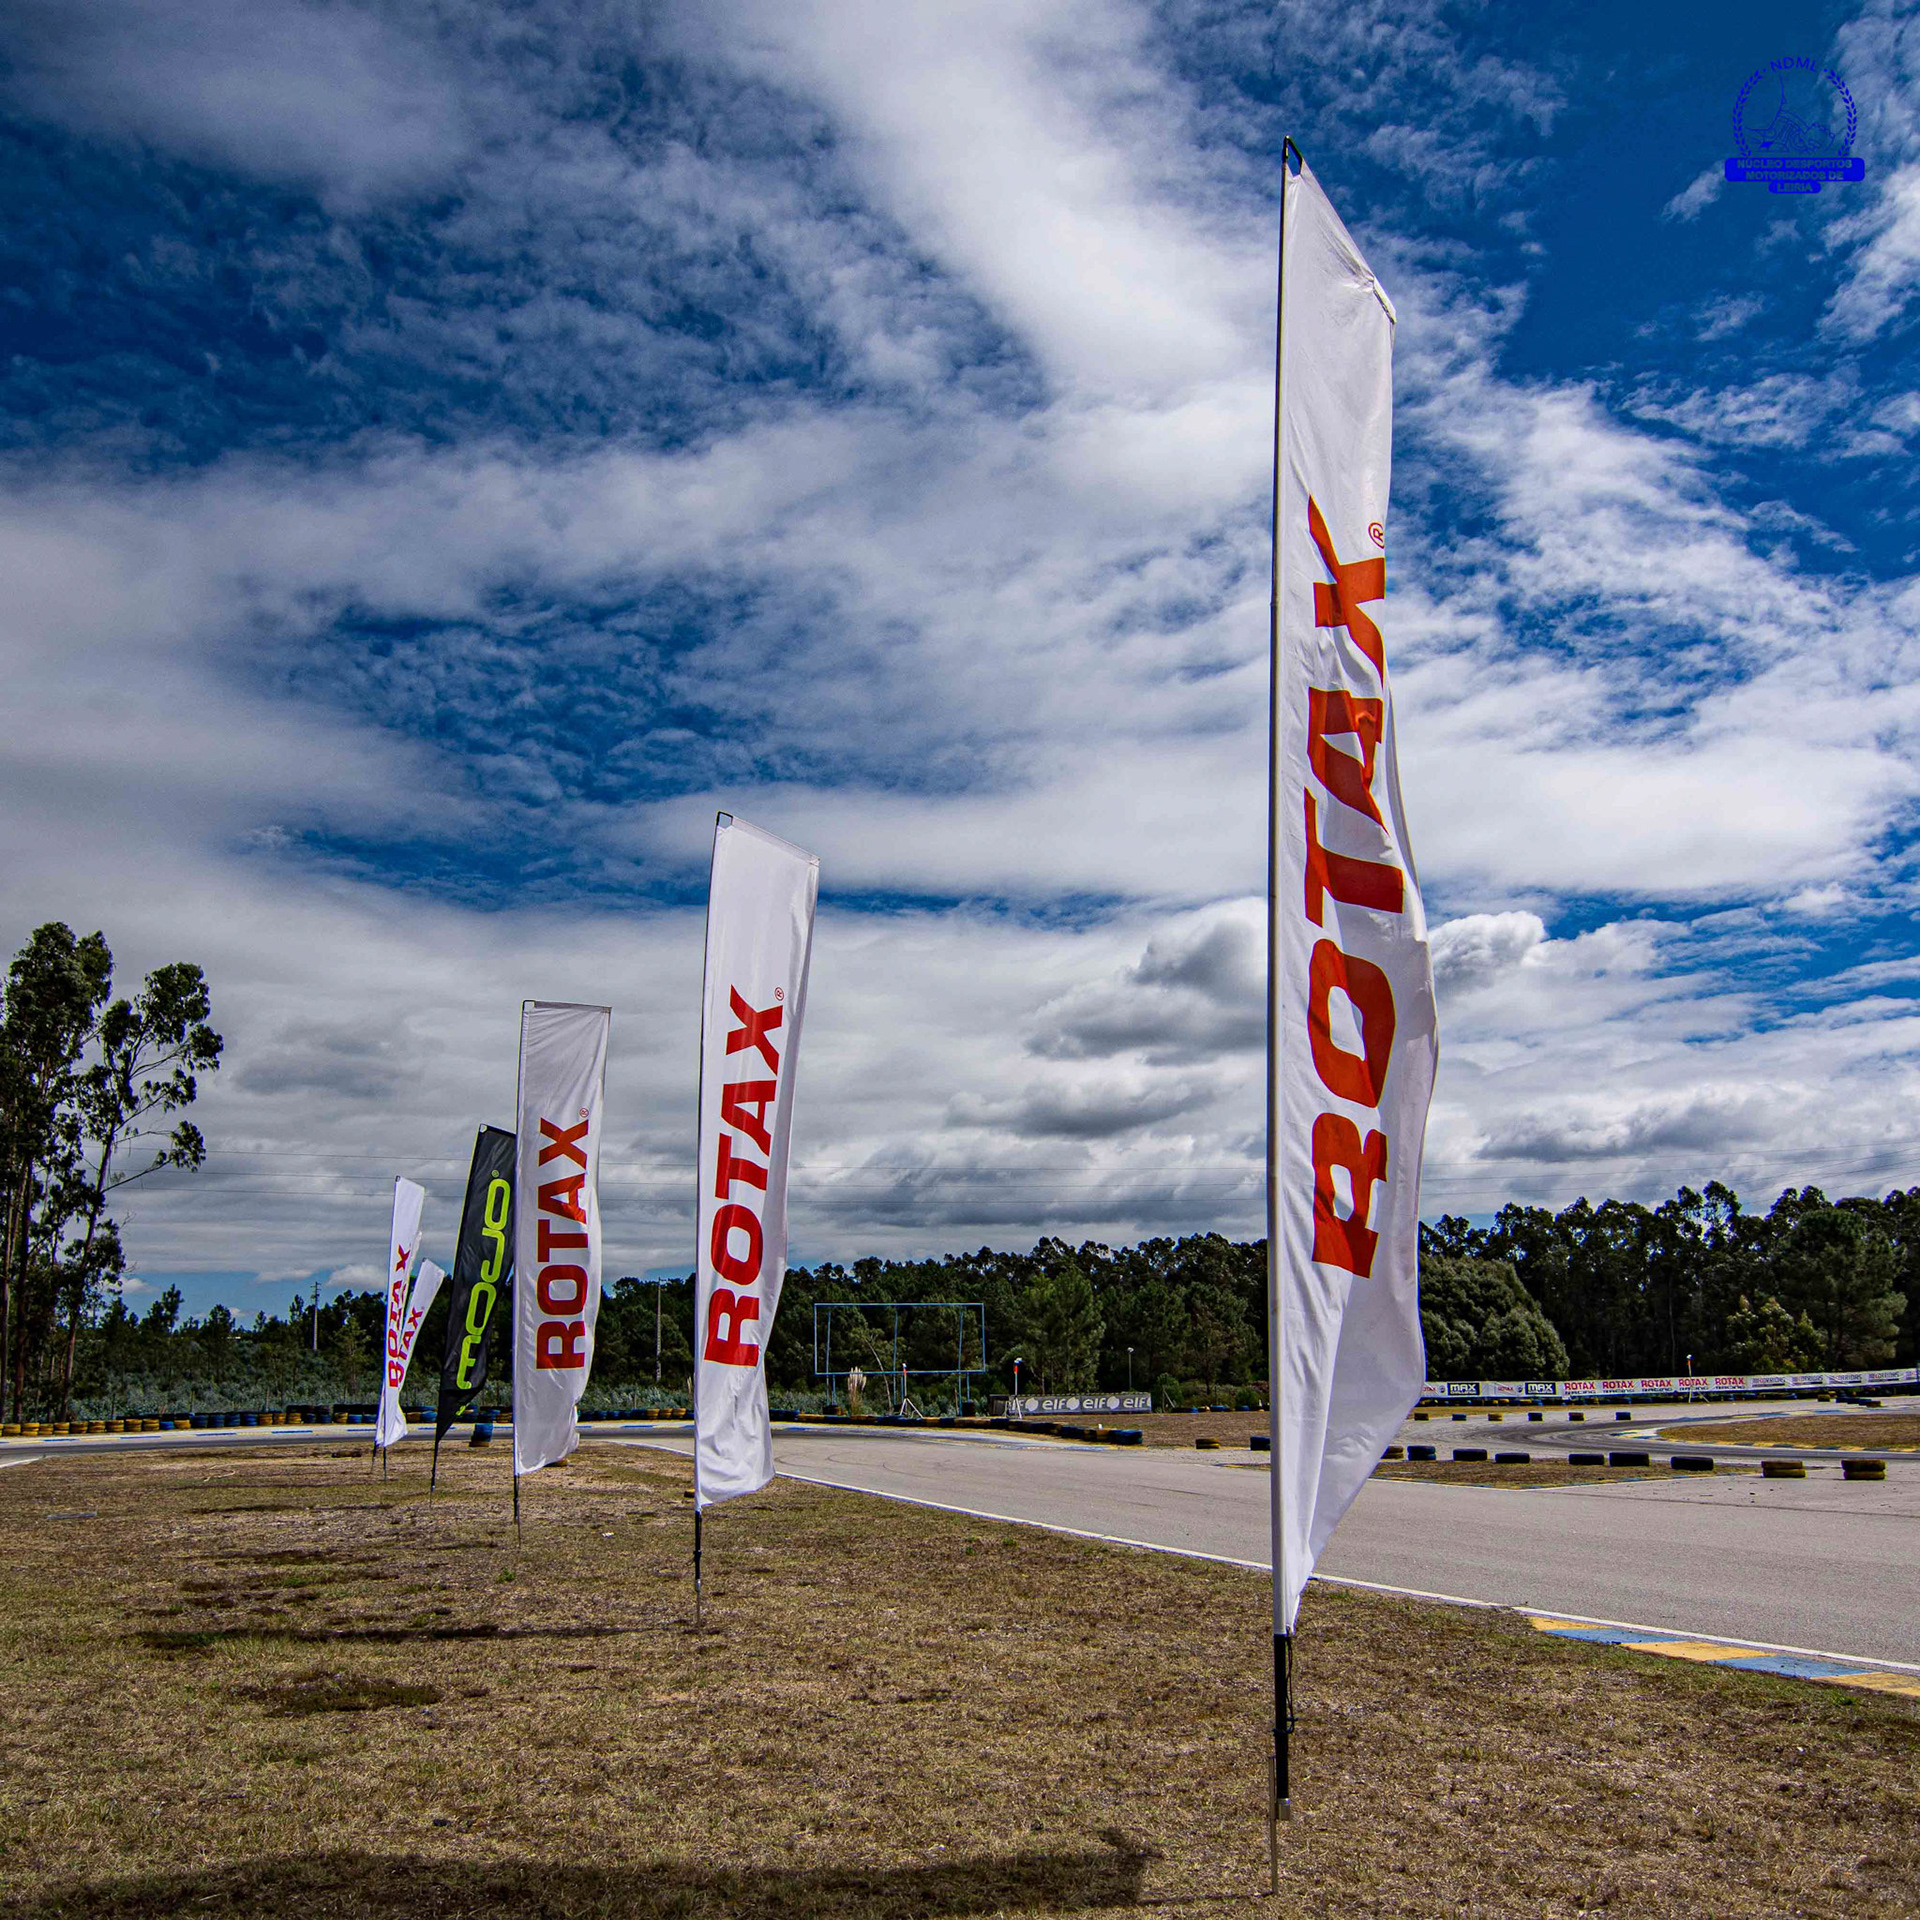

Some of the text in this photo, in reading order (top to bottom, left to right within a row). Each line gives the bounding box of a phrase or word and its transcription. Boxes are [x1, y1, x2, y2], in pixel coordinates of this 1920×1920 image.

[1564, 1381, 1596, 1390] ROTAX
[1602, 1380, 1634, 1389] ROTAX
[1641, 1379, 1672, 1388] ROTAX
[1678, 1378, 1708, 1386] ROTAX
[1715, 1376, 1745, 1386] ROTAX
[1042, 1398, 1066, 1410] elf
[1082, 1397, 1106, 1409] elf
[1123, 1396, 1146, 1408] elf
